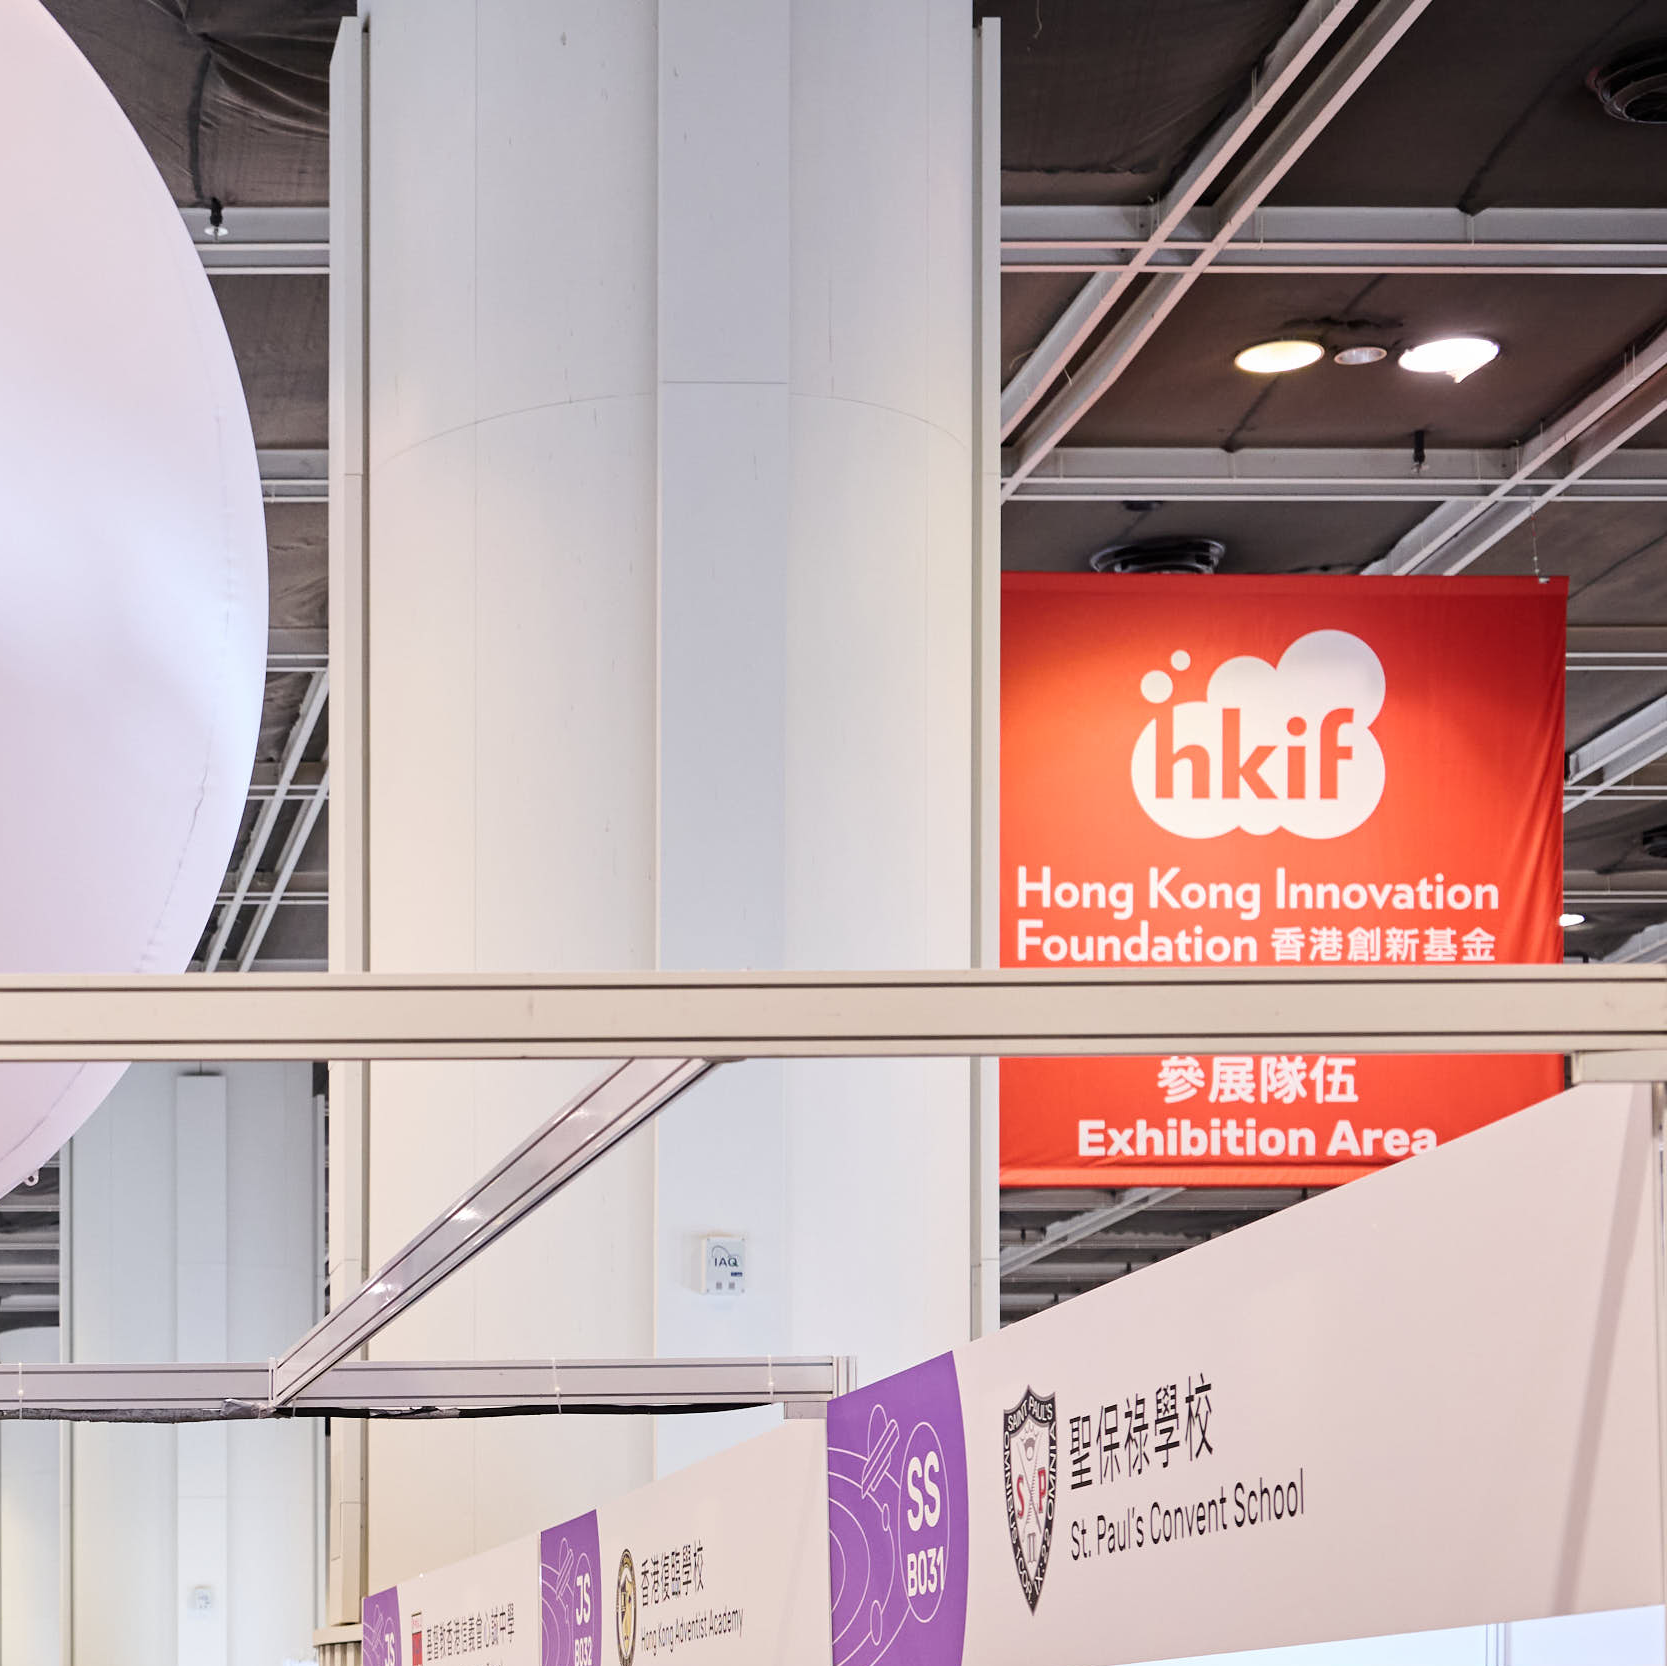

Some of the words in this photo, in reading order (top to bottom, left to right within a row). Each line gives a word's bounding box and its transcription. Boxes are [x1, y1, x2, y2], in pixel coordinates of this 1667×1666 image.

[1155, 707, 1355, 800] hkif
[1017, 866, 1133, 919] Hong
[1149, 867, 1261, 919] Kong
[1276, 867, 1499, 911] Innovation
[1017, 920, 1257, 963] Foundation
[1271, 926, 1496, 963] 香港創新基金
[1157, 1056, 1358, 1104] 參展隊伍
[1078, 1119, 1315, 1157] Exhibition
[1327, 1120, 1437, 1157] Area
[1069, 1373, 1213, 1490] 聖保祿學校
[907, 1451, 941, 1532] SS
[1071, 1518, 1092, 1561] St.
[1097, 1505, 1145, 1558] Paul's
[1150, 1487, 1229, 1545] Convent
[1234, 1468, 1305, 1528] School
[907, 1546, 945, 1598] B031
[575, 1573, 591, 1626] JS
[641, 1626, 657, 1657] Hong
[658, 1621, 674, 1653] Kong
[675, 1611, 708, 1644] Adventist
[709, 1605, 744, 1639] Academy
